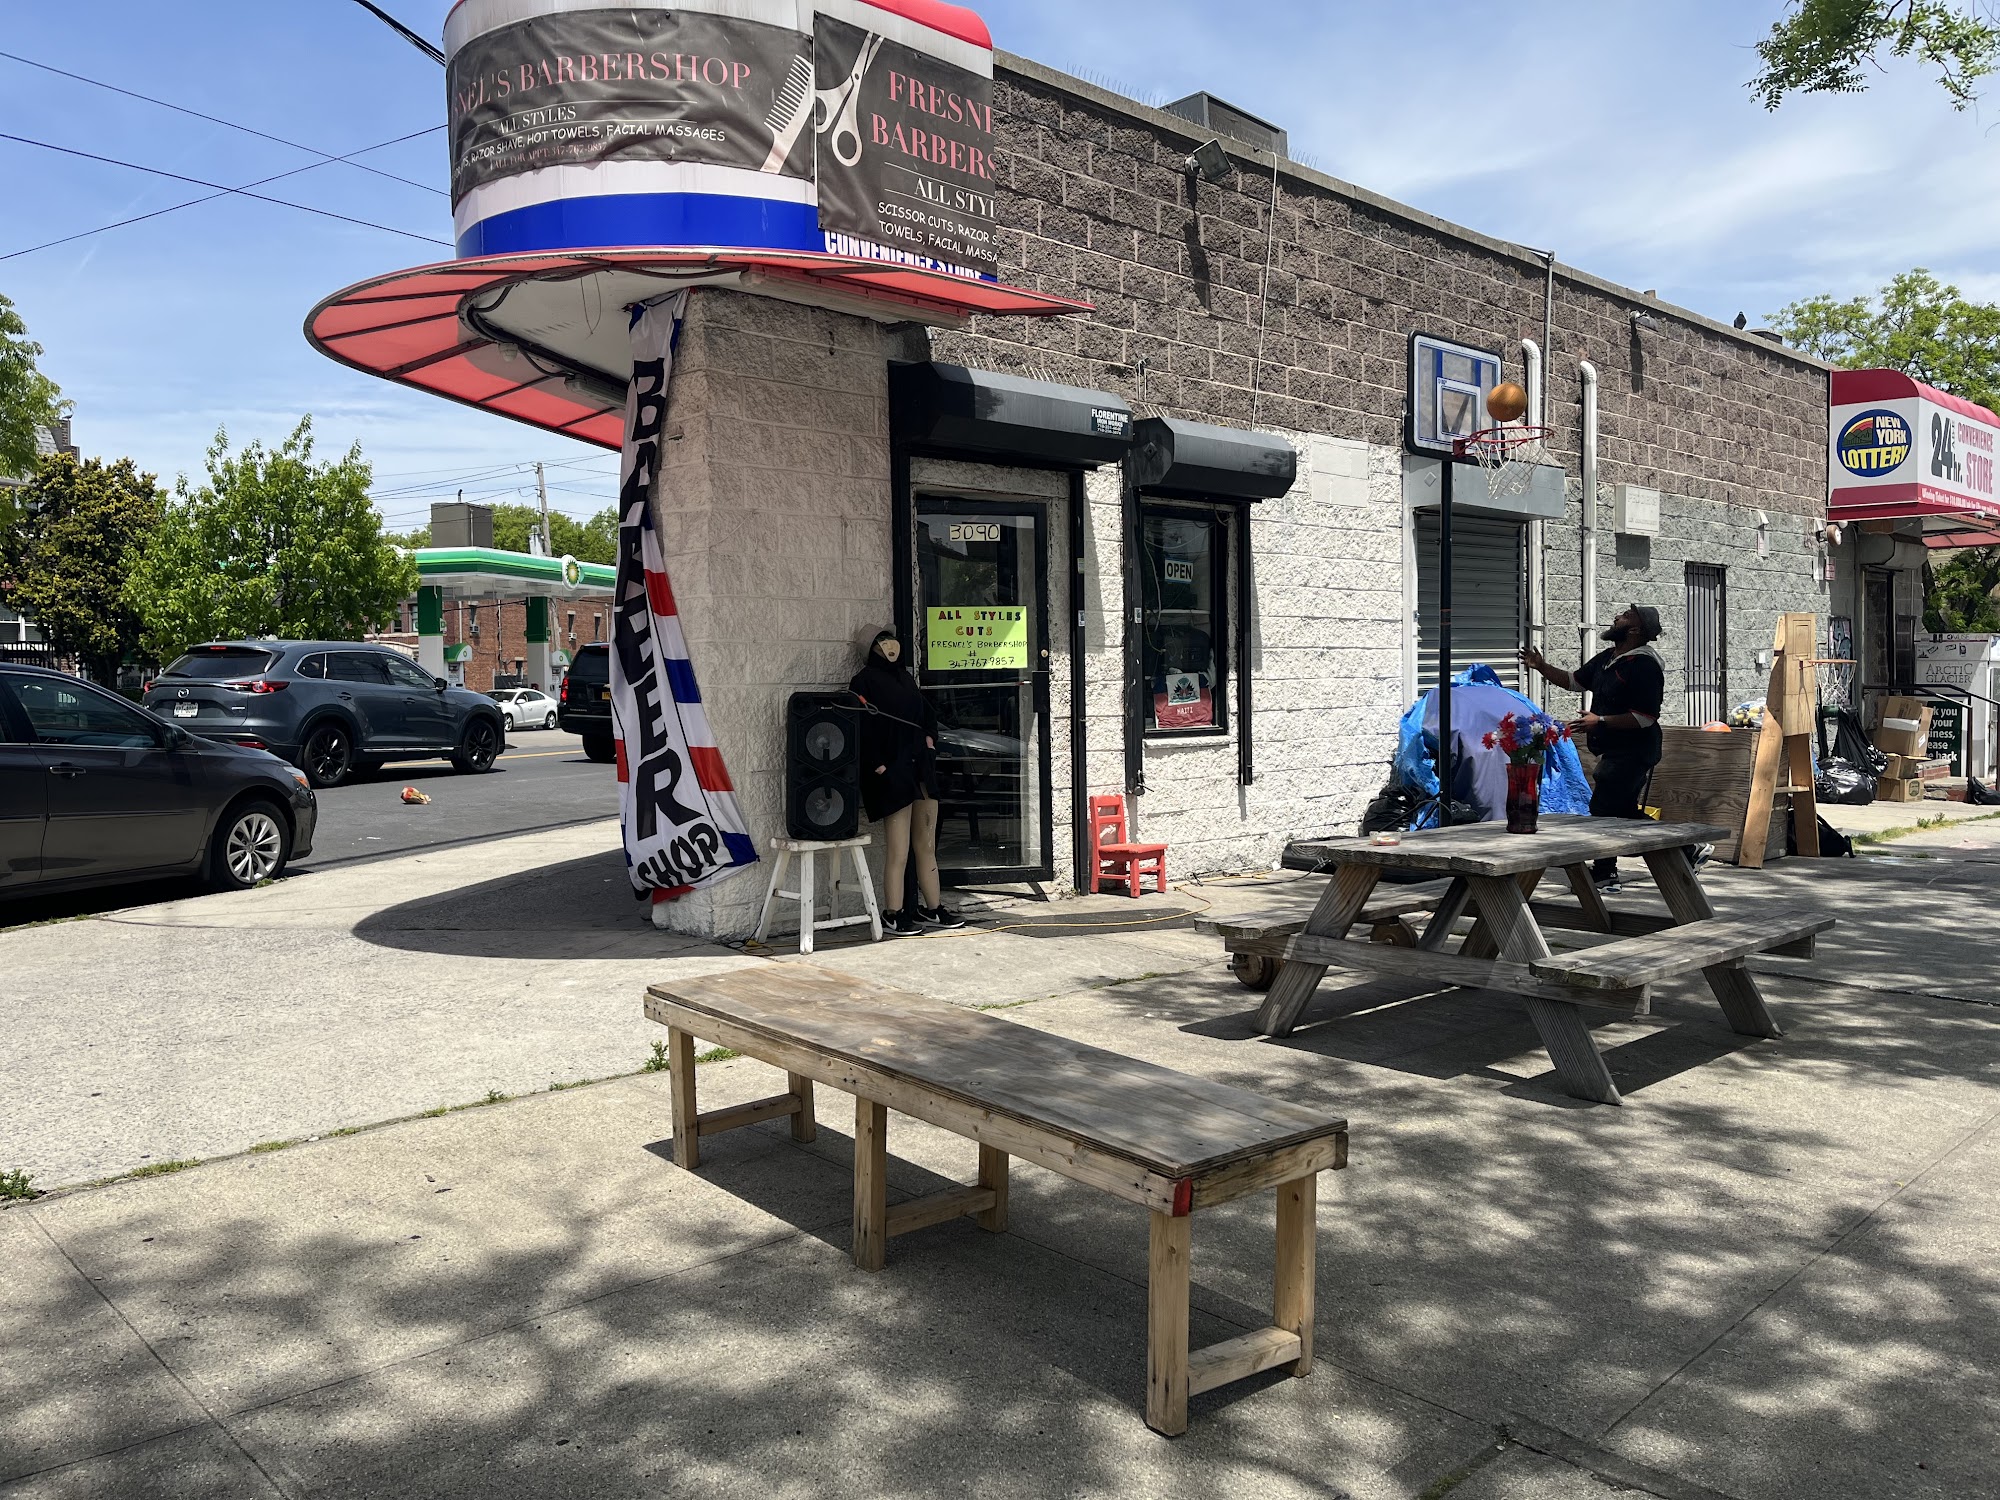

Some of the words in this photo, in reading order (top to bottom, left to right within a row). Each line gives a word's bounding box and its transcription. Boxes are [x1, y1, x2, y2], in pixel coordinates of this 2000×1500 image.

[519, 53, 751, 91] BARBERSHOP
[499, 117, 520, 135] ALL
[522, 105, 577, 128] STYLES
[471, 146, 495, 164] RAZOR
[497, 136, 525, 154] SHAVE,
[527, 131, 548, 145] HOT
[551, 126, 604, 140] TOWELS,
[606, 124, 652, 138] FACIAL
[655, 124, 726, 142] MASSAGES
[914, 177, 951, 206] ALL
[877, 202, 926, 224] SCISSOR
[927, 215, 957, 235] CUTS,
[958, 223, 989, 244] RAZOR
[878, 221, 925, 246] TOWELS,
[928, 233, 963, 254] FACIAL
[1091, 408, 1128, 423] FLORENTINE
[1875, 416, 1901, 429] NEW
[1876, 429, 1907, 446] YORK
[1957, 421, 1993, 453] CONVENIENCE
[1931, 412, 1953, 480] 24
[1842, 445, 1909, 470] LOTTERY
[1966, 451, 1993, 494] STORE
[951, 524, 1000, 541] 3090
[1166, 562, 1192, 580] OPEN
[938, 610, 962, 621] ALL
[974, 611, 1021, 621] STYLES
[956, 626, 993, 637] CUTS
[931, 640, 972, 649] FRESNEL'S
[977, 640, 1028, 649] BARBERSHOP
[1926, 663, 1973, 675] ARCTIC
[1926, 675, 1973, 684] GLACIER
[1941, 707, 1958, 717] you
[1933, 719, 1954, 729] your
[1928, 729, 1956, 739] iness,
[1928, 741, 1948, 750] ease
[1936, 751, 1958, 762] back
[638, 823, 719, 888] SHOP
